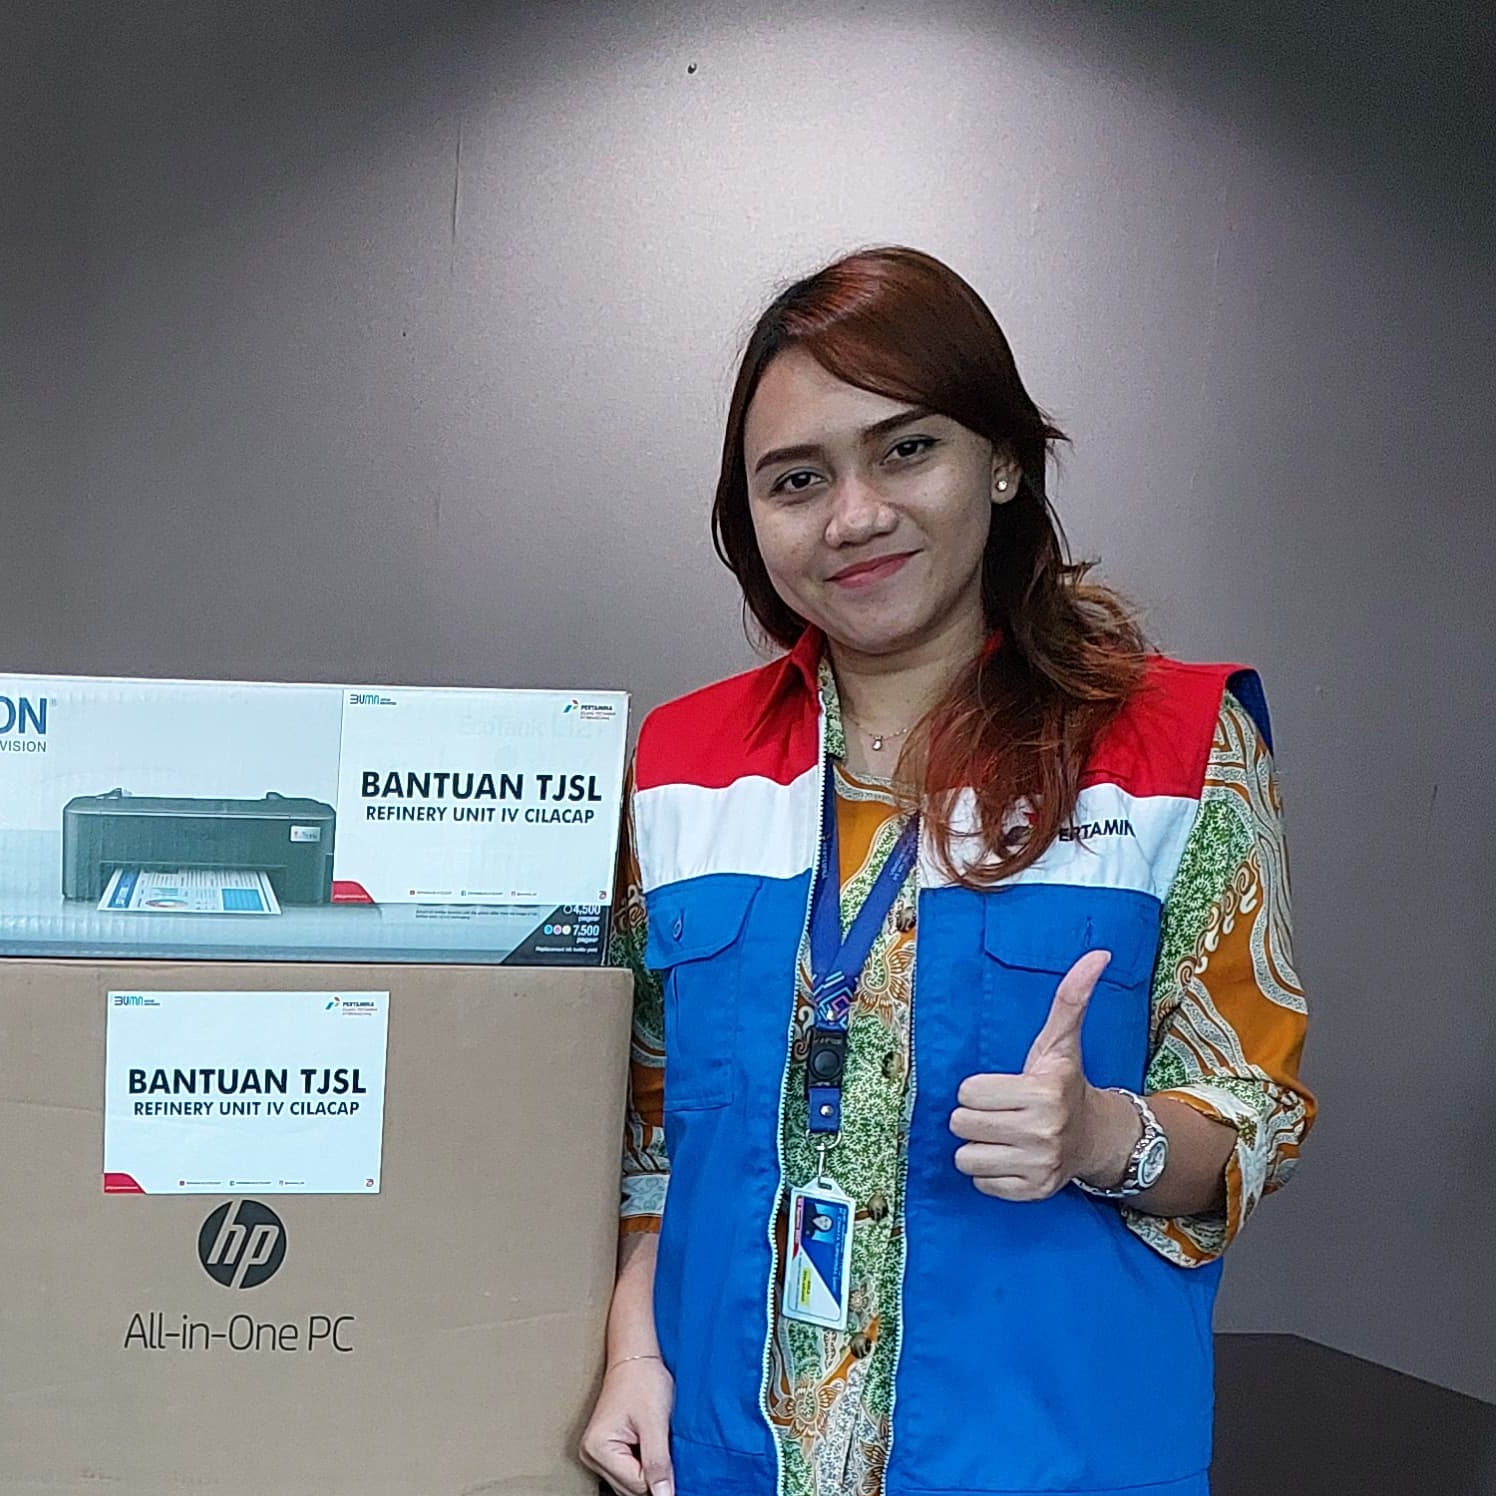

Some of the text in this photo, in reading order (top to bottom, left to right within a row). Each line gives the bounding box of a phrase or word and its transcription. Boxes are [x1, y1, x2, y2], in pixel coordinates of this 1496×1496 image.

[0, 740, 47, 752] VISION
[361, 771, 602, 802] BANTUAN TJSL
[365, 805, 595, 824] REFINERY UNIT IV CILACAP
[128, 1068, 367, 1095] BANTUAN TJSL
[134, 1101, 360, 1116] REFINERY UNIT IV CILACAP
[206, 1199, 281, 1289] hp
[124, 1312, 355, 1352] All-in-One PC
